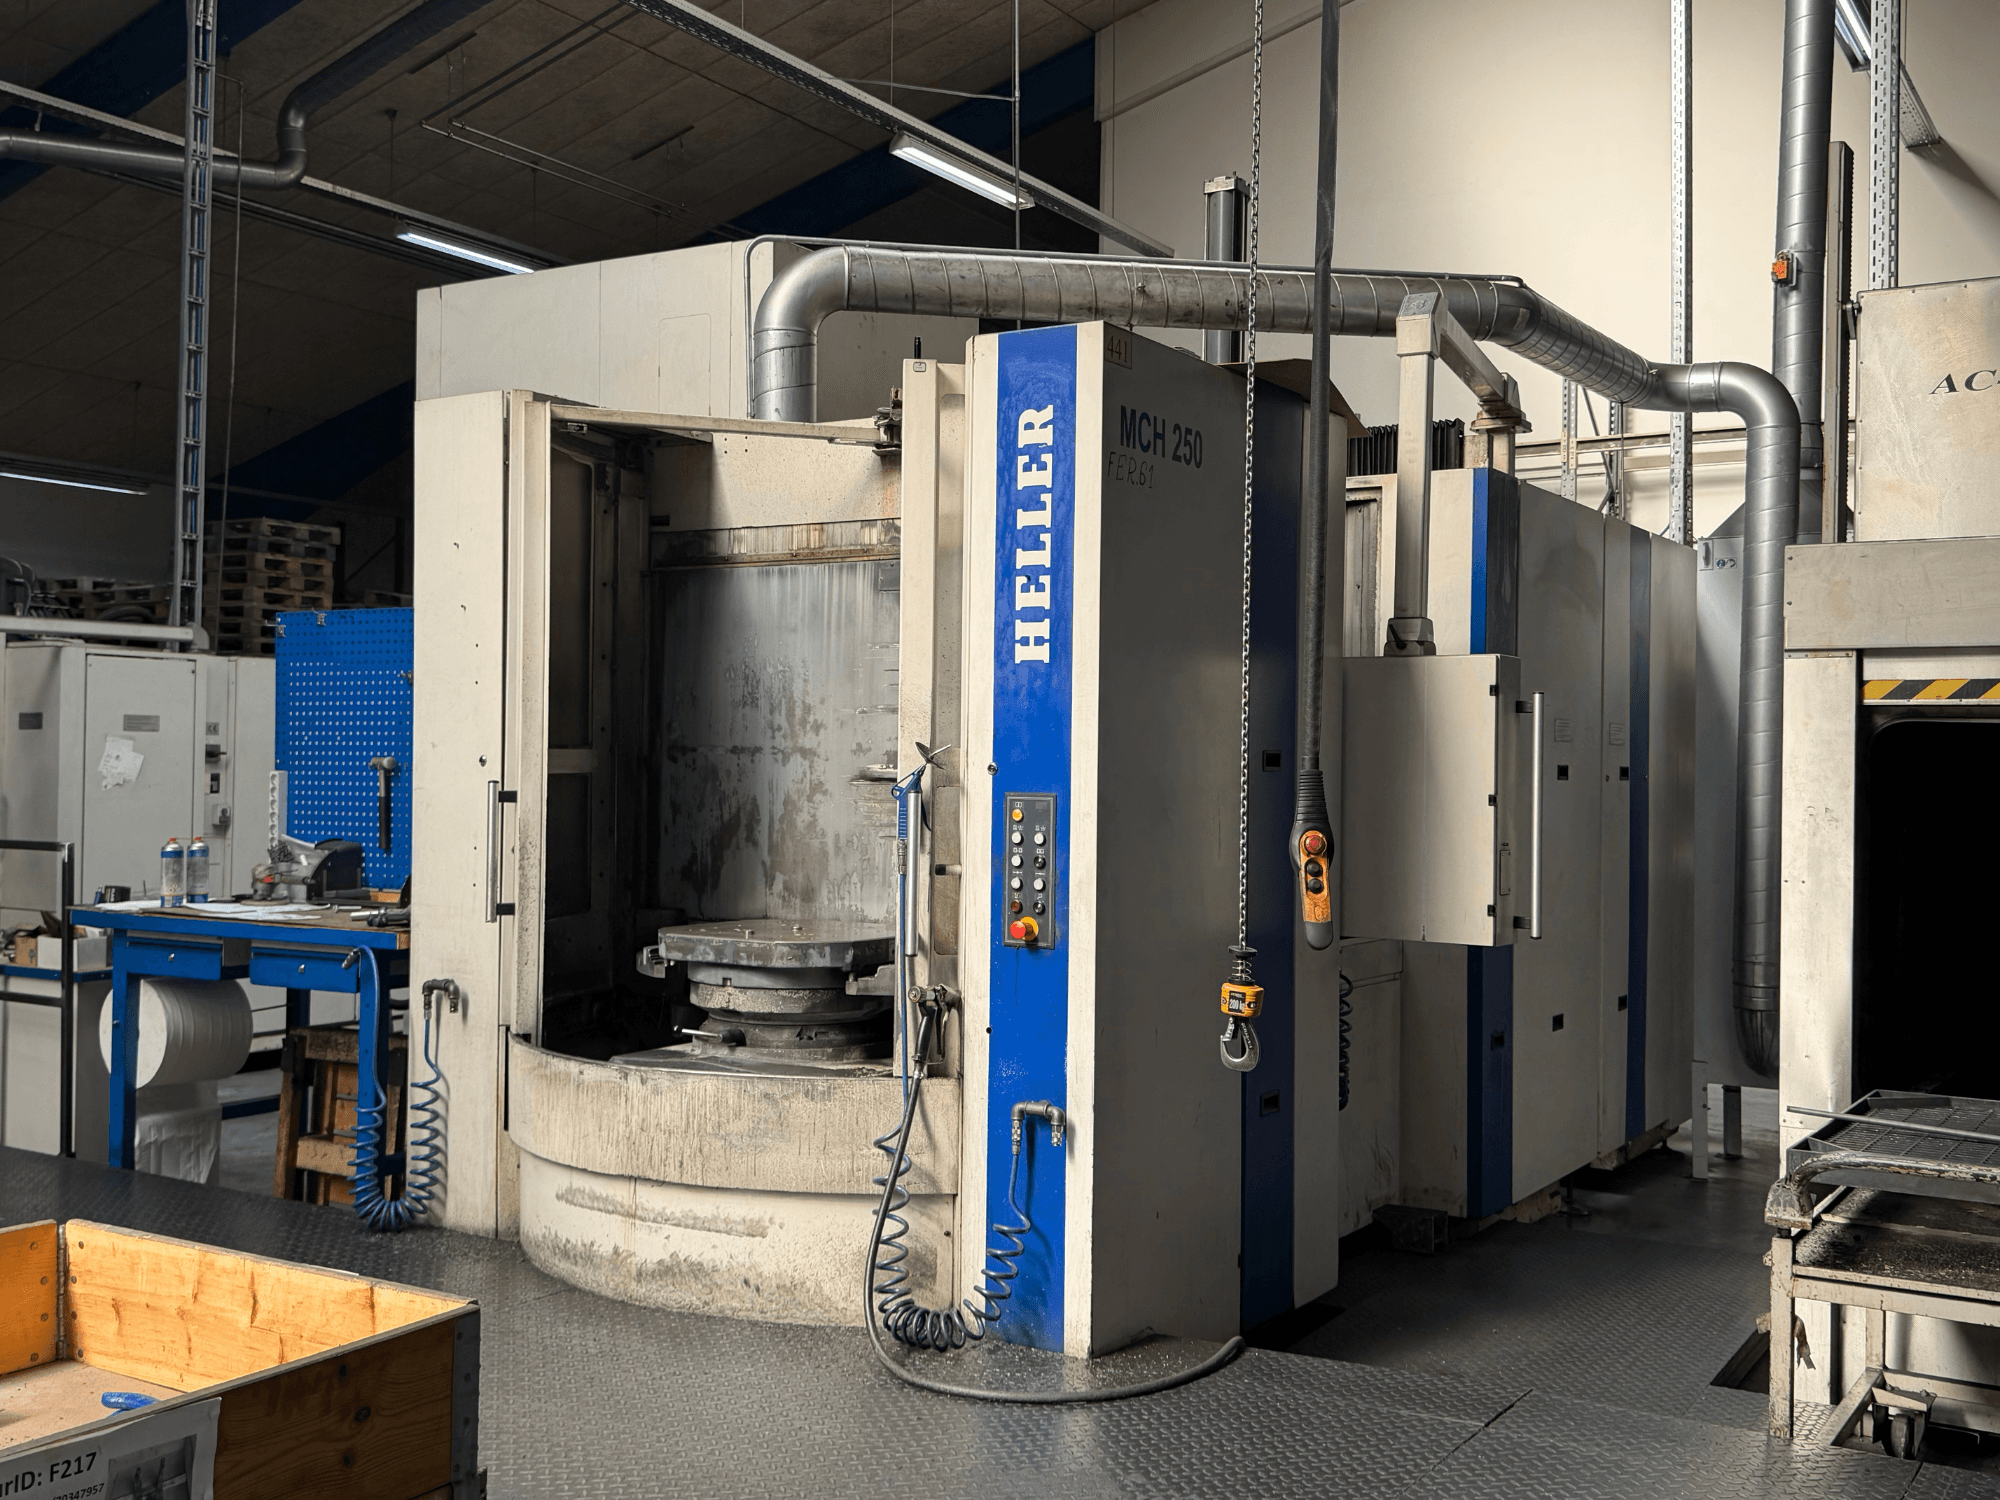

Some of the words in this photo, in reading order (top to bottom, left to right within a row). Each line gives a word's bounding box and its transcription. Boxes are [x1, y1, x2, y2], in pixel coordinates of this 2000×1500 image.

[1107, 335, 1127, 363] 441
[1120, 405, 1166, 458] MCH
[1171, 422, 1203, 469] 250
[1014, 405, 1053, 664] HELLER
[0, 1471, 42, 1498] rID:
[49, 1451, 97, 1483] F217
